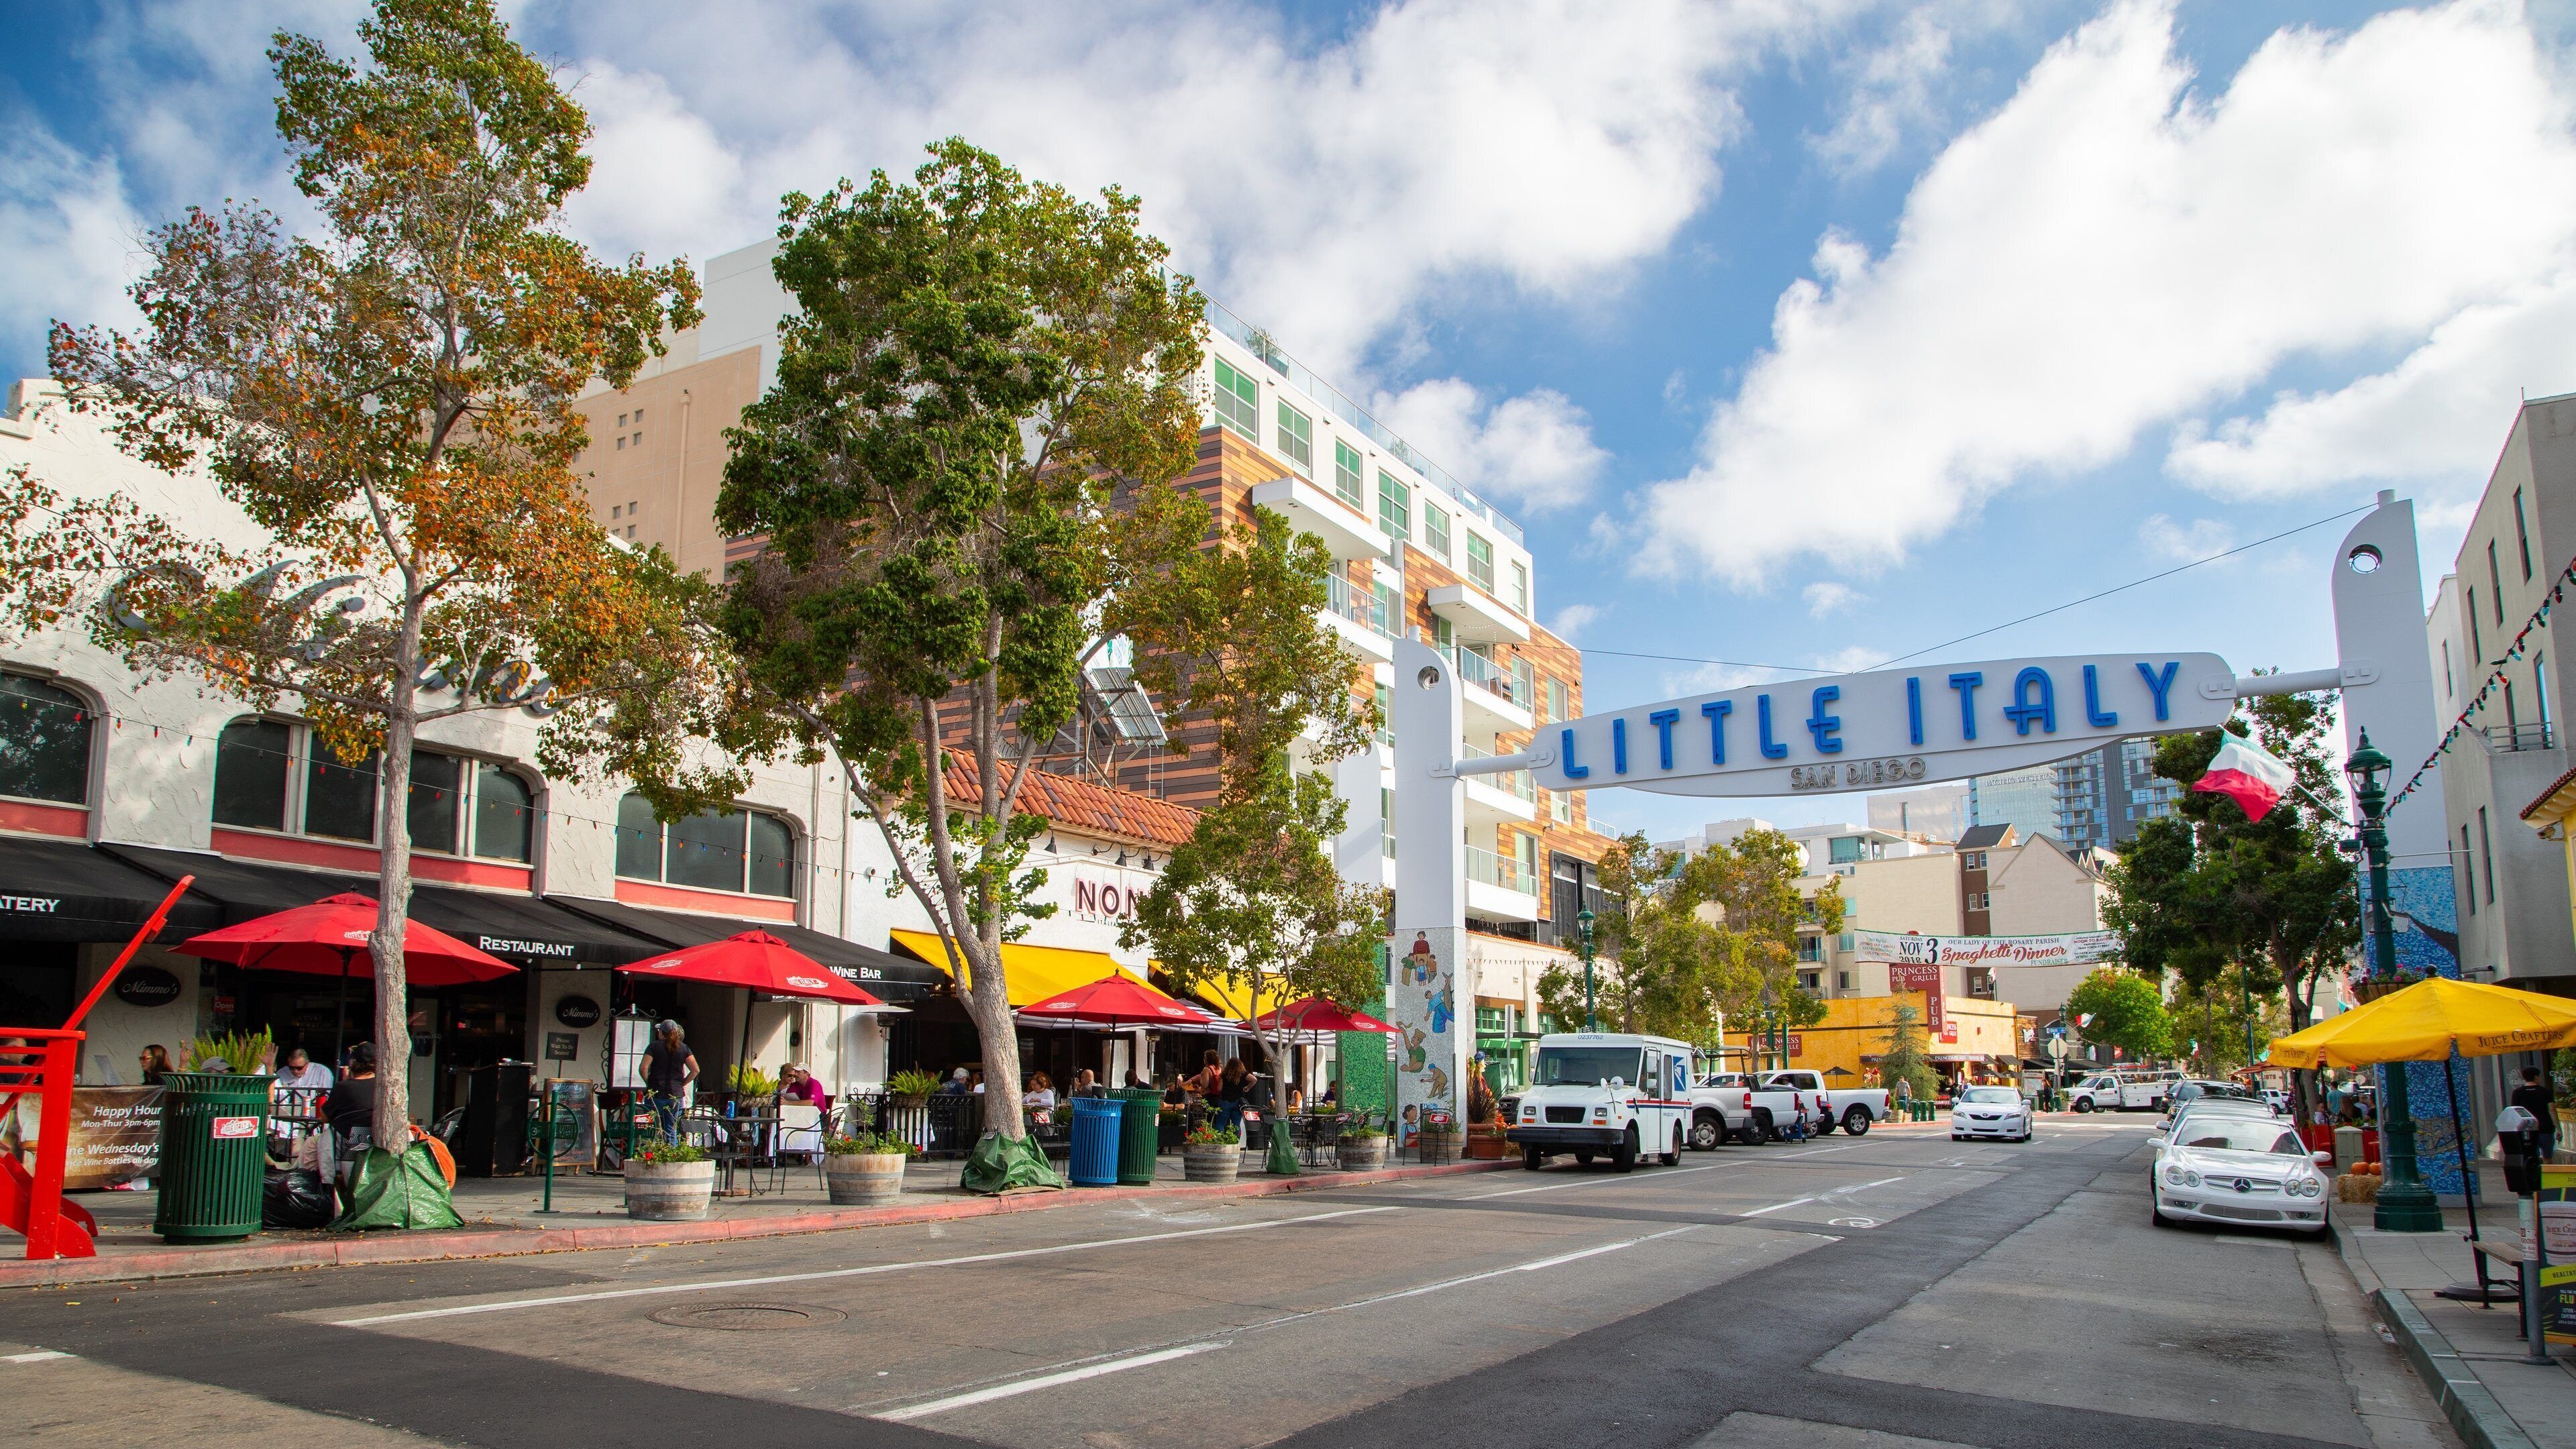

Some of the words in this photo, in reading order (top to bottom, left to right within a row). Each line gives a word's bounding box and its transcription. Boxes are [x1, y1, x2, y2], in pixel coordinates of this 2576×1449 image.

[1560, 685, 1843, 780] LITTLE
[1905, 661, 2180, 745] ITALY
[1790, 765, 1837, 790] SAN
[1845, 756, 1927, 784] DIEGO
[1986, 778, 2016, 787] PACIFIC
[2017, 773, 2055, 784] WESTERN
[479, 936, 574, 957] RESTAURANT
[1898, 941, 1923, 955] NOV
[1925, 938, 1938, 964] 3
[1941, 943, 2012, 964] Spaghetti
[2013, 945, 2067, 962] Dinner
[2031, 958, 2070, 966] FUNDRAISER
[829, 966, 857, 979] WINE
[860, 966, 881, 979] BAR
[1892, 966, 1937, 976] PRINCESS
[1912, 974, 1938, 982] GRILLE
[122, 980, 178, 994] Mimmo's
[215, 1001, 234, 1010] Open
[563, 1006, 598, 1018] Mimmo's
[1930, 996, 1939, 1026] PUB
[2477, 1034, 2509, 1047] JUICE
[2512, 1030, 2564, 1042] CRAFTERS
[93, 1106, 132, 1119] Happy
[134, 1106, 162, 1115] Hour
[81, 1120, 123, 1128] Mon-Thur
[125, 1119, 161, 1128] 3pm-6pm
[66, 1146, 85, 1156] ine
[88, 1142, 160, 1155] Wednesday's
[103, 1157, 131, 1165] Bottles
[144, 1157, 160, 1166] day
[2552, 1270, 2576, 1279] HEALTHY
[2560, 1294, 2575, 1304] FLU
